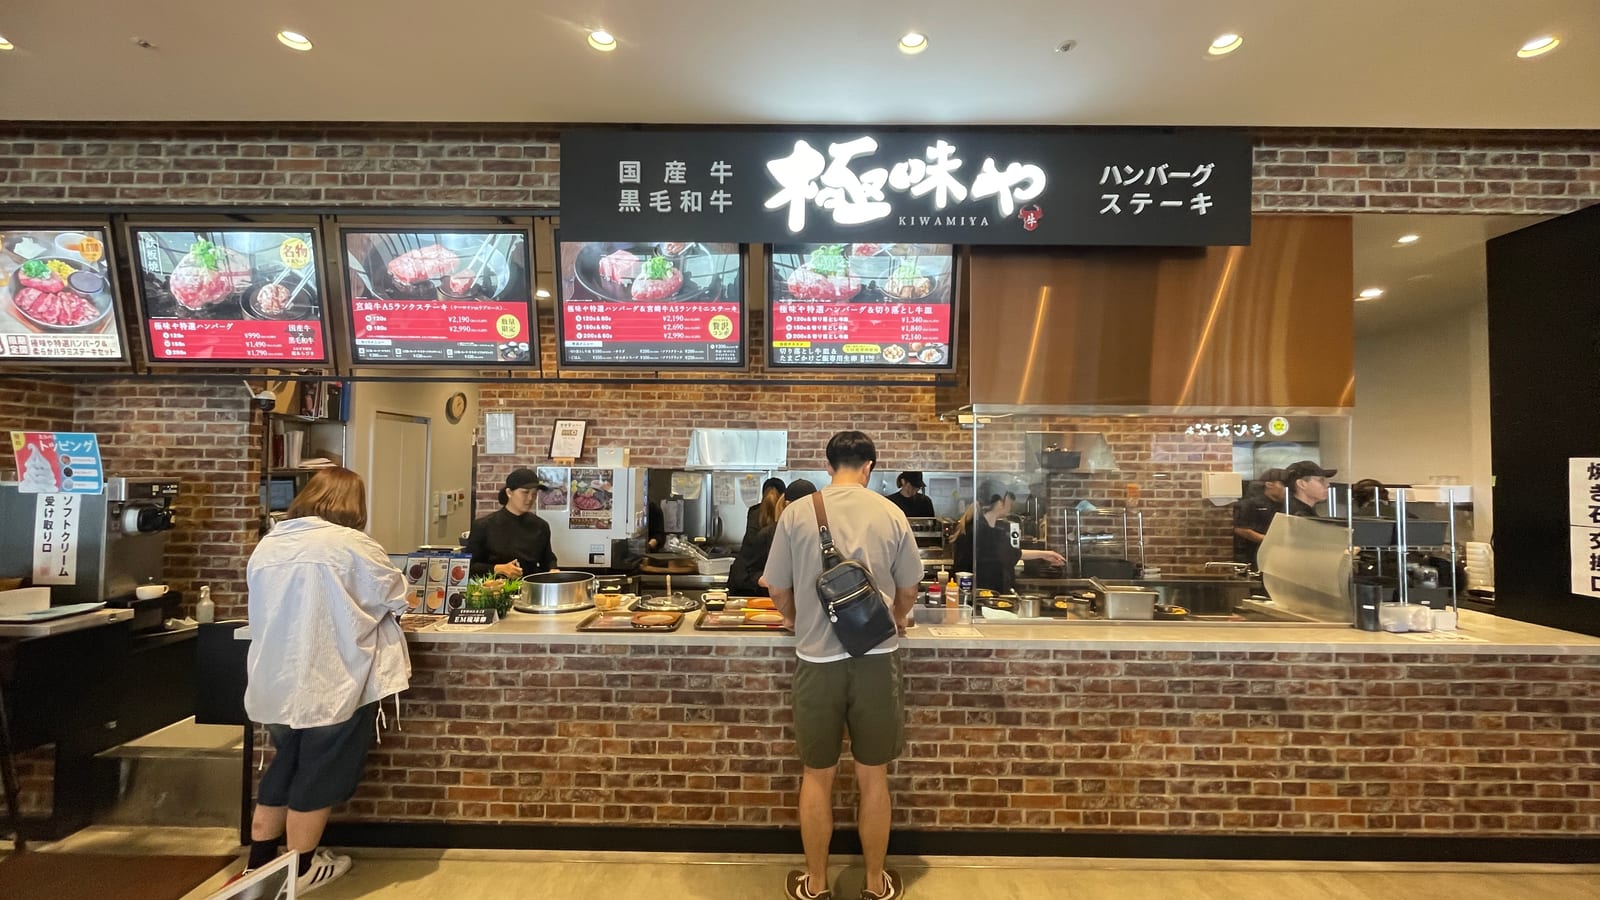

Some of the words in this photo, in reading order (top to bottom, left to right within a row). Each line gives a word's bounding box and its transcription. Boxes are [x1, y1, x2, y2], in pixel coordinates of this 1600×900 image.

[619, 160, 733, 184] 国産牛
[1099, 162, 1215, 188] ハンバーグ
[764, 136, 1047, 233] 極味や
[618, 189, 733, 213] 黒毛和牛
[1099, 193, 1214, 216] ステーキ
[898, 215, 990, 226] KIWAMIYA
[1025, 214, 1038, 227] 牛
[283, 243, 308, 258] 名物
[355, 302, 448, 311] 宮崎牛A5ランクステーキ
[779, 304, 933, 315] 極味や特選ハンバーグ&切り落とし牛皿
[448, 315, 470, 323] ¥2,190
[662, 315, 684, 323] ¥2,190
[154, 321, 234, 331] 極味や特選ハンバーグ
[288, 324, 312, 332] 国産牛
[288, 336, 314, 345] 黒毛和牛
[39, 440, 94, 452] トッピング
[42, 495, 56, 553] 受け取り口
[58, 495, 74, 577] ソフトクリーム
